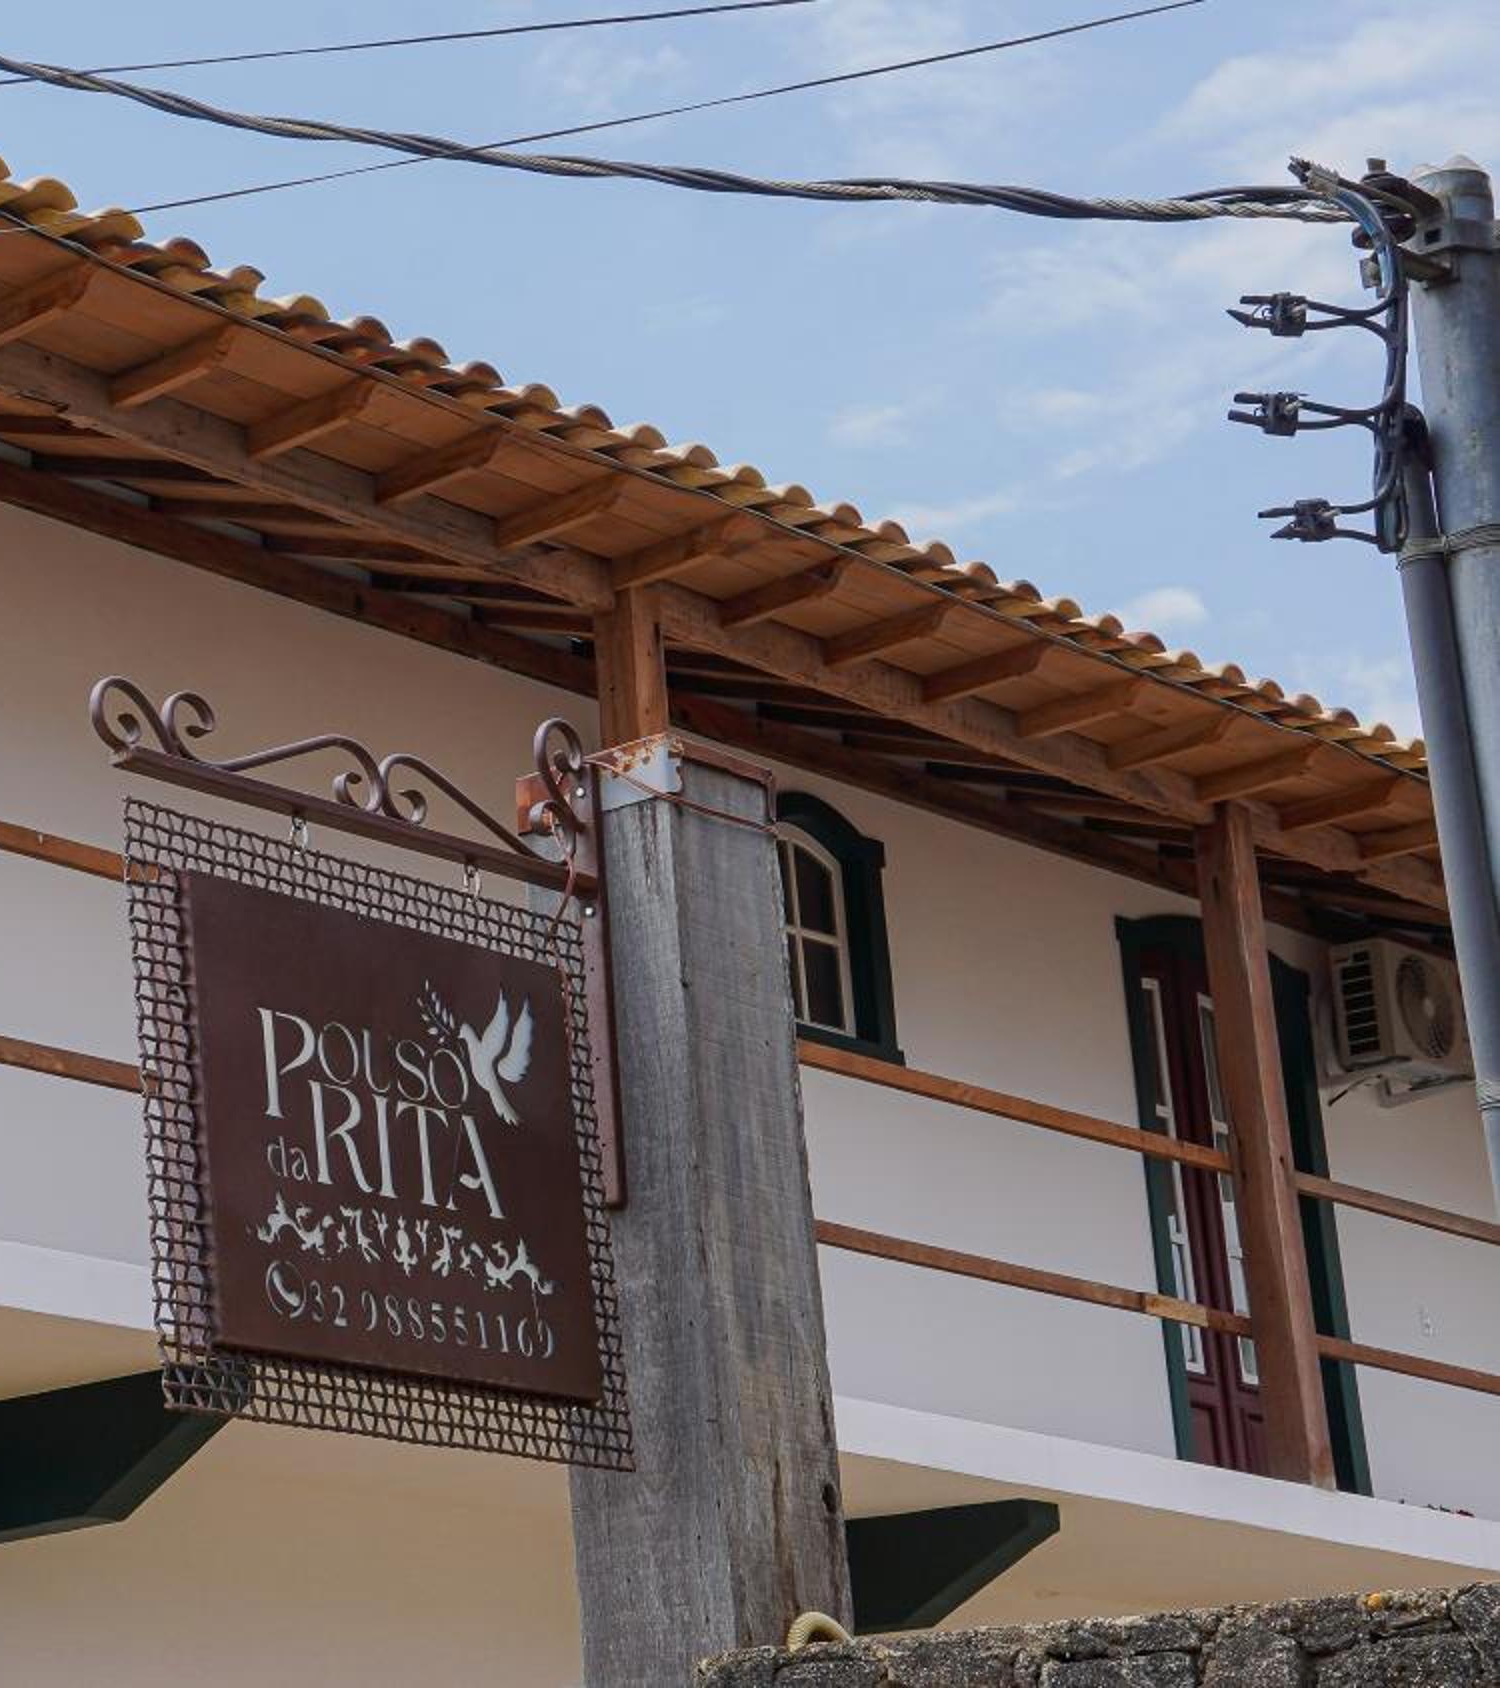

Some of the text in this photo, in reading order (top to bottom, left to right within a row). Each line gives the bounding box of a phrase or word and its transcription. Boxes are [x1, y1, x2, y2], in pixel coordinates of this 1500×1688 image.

[257, 1007, 469, 1119] POUSO
[267, 1079, 506, 1219] da RITA
[309, 1280, 348, 1327] 32
